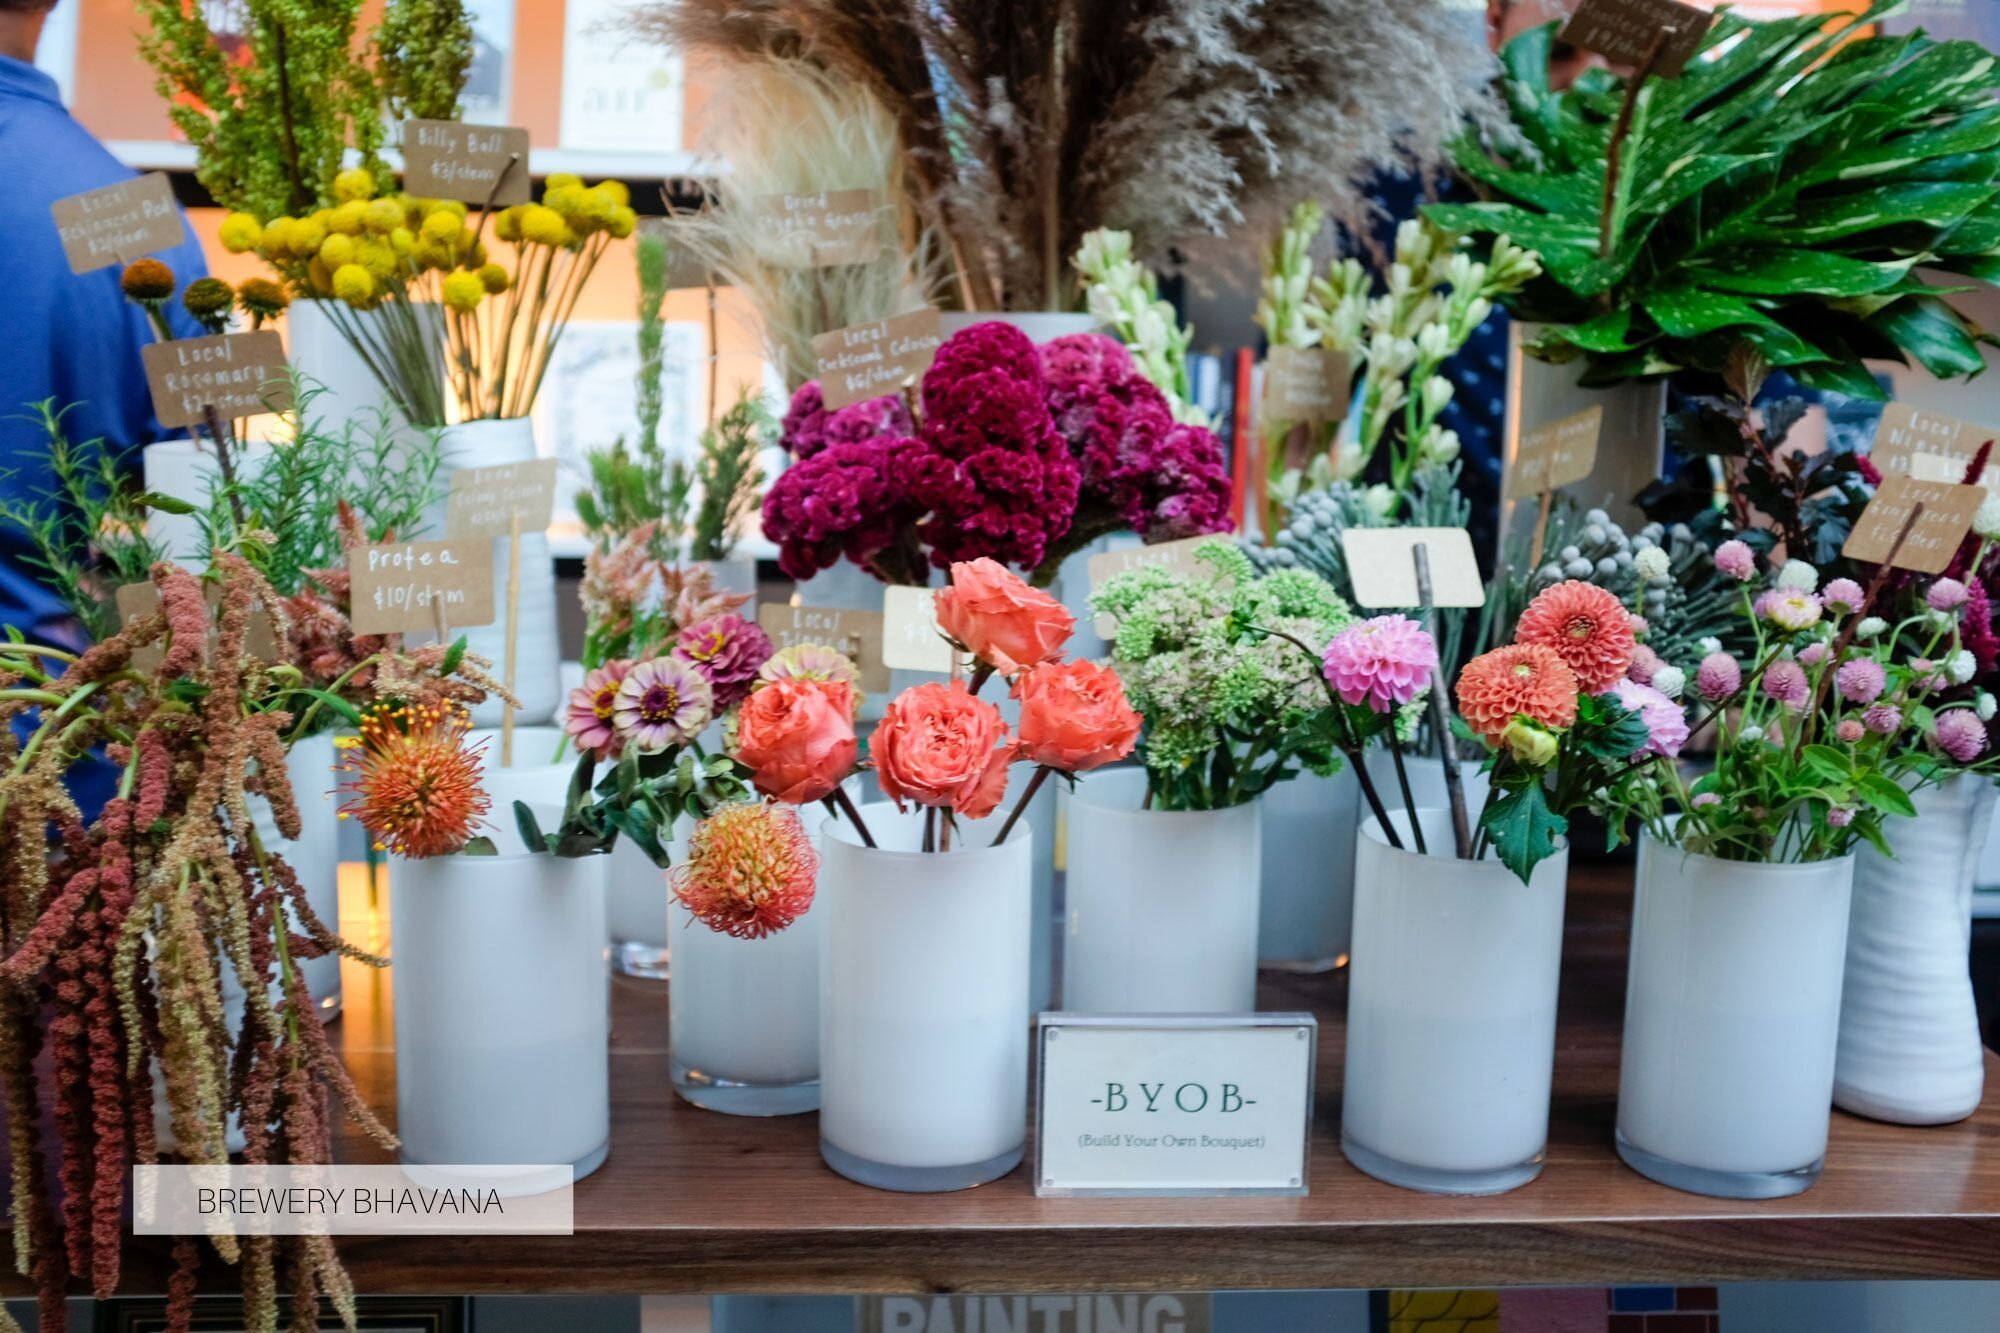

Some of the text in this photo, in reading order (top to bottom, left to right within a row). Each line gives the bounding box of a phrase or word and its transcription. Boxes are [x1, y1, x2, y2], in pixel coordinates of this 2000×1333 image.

[418, 126, 502, 155] Billy Ball
[81, 185, 127, 214] Local
[142, 195, 171, 219] Pod
[843, 318, 888, 348] Local
[177, 337, 233, 368] Local
[164, 365, 266, 394] Rosemary
[1909, 410, 1962, 442] Local
[1900, 482, 1953, 504] Local
[373, 582, 465, 612] $10/stm
[793, 609, 841, 633] Local
[1078, 1133, 1266, 1151] (Build Your Own Bouquet)
[883, 1295, 1185, 1333] PAINTING
